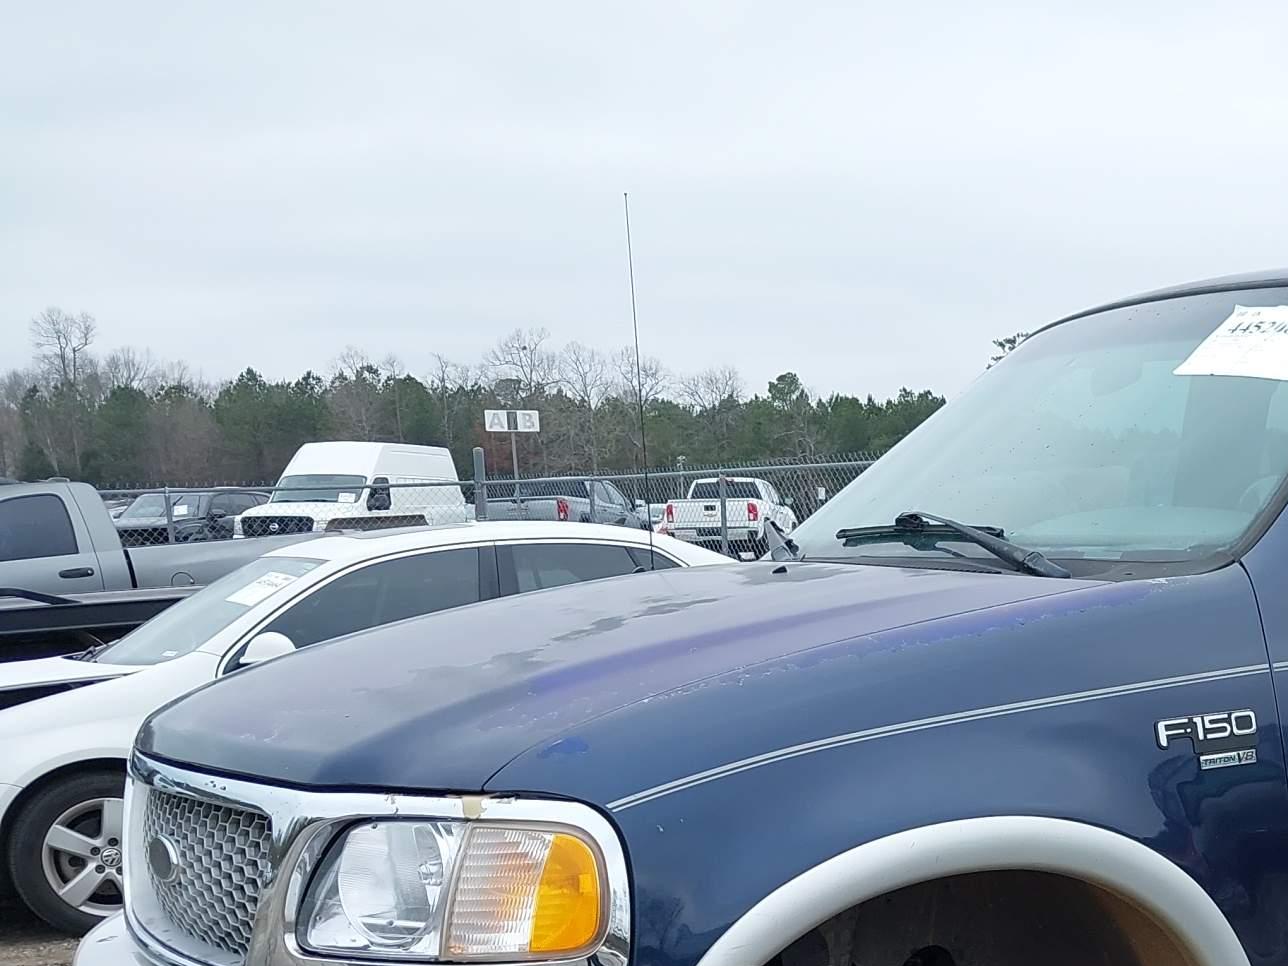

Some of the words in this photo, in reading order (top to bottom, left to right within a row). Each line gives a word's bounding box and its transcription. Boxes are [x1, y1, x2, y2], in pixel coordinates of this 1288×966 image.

[489, 412, 505, 429] A
[520, 412, 535, 430] B
[1201, 754, 1236, 767] TRITON
[1236, 750, 1255, 763] V8
